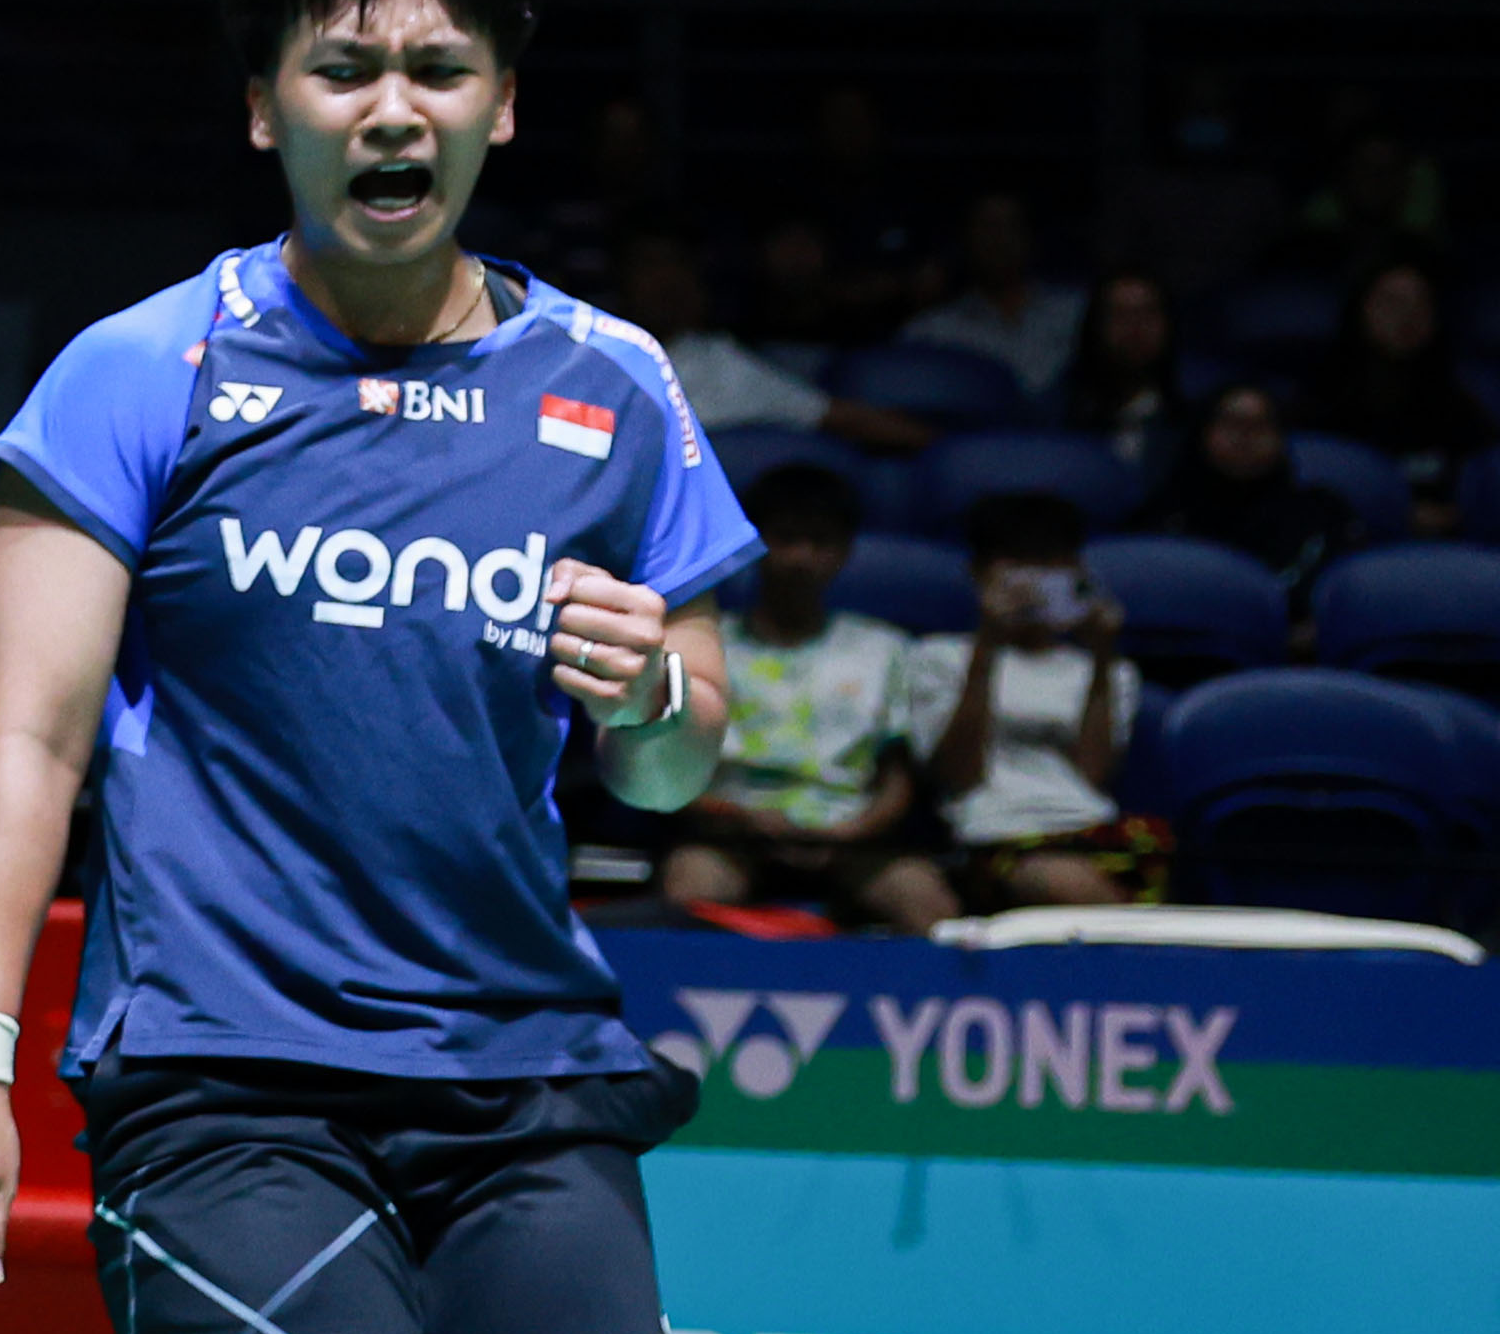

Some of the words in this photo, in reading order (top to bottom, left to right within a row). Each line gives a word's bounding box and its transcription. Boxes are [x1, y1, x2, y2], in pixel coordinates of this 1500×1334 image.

[403, 379, 486, 423] BNI
[484, 619, 512, 650] by
[868, 995, 1239, 1117] YONEX
